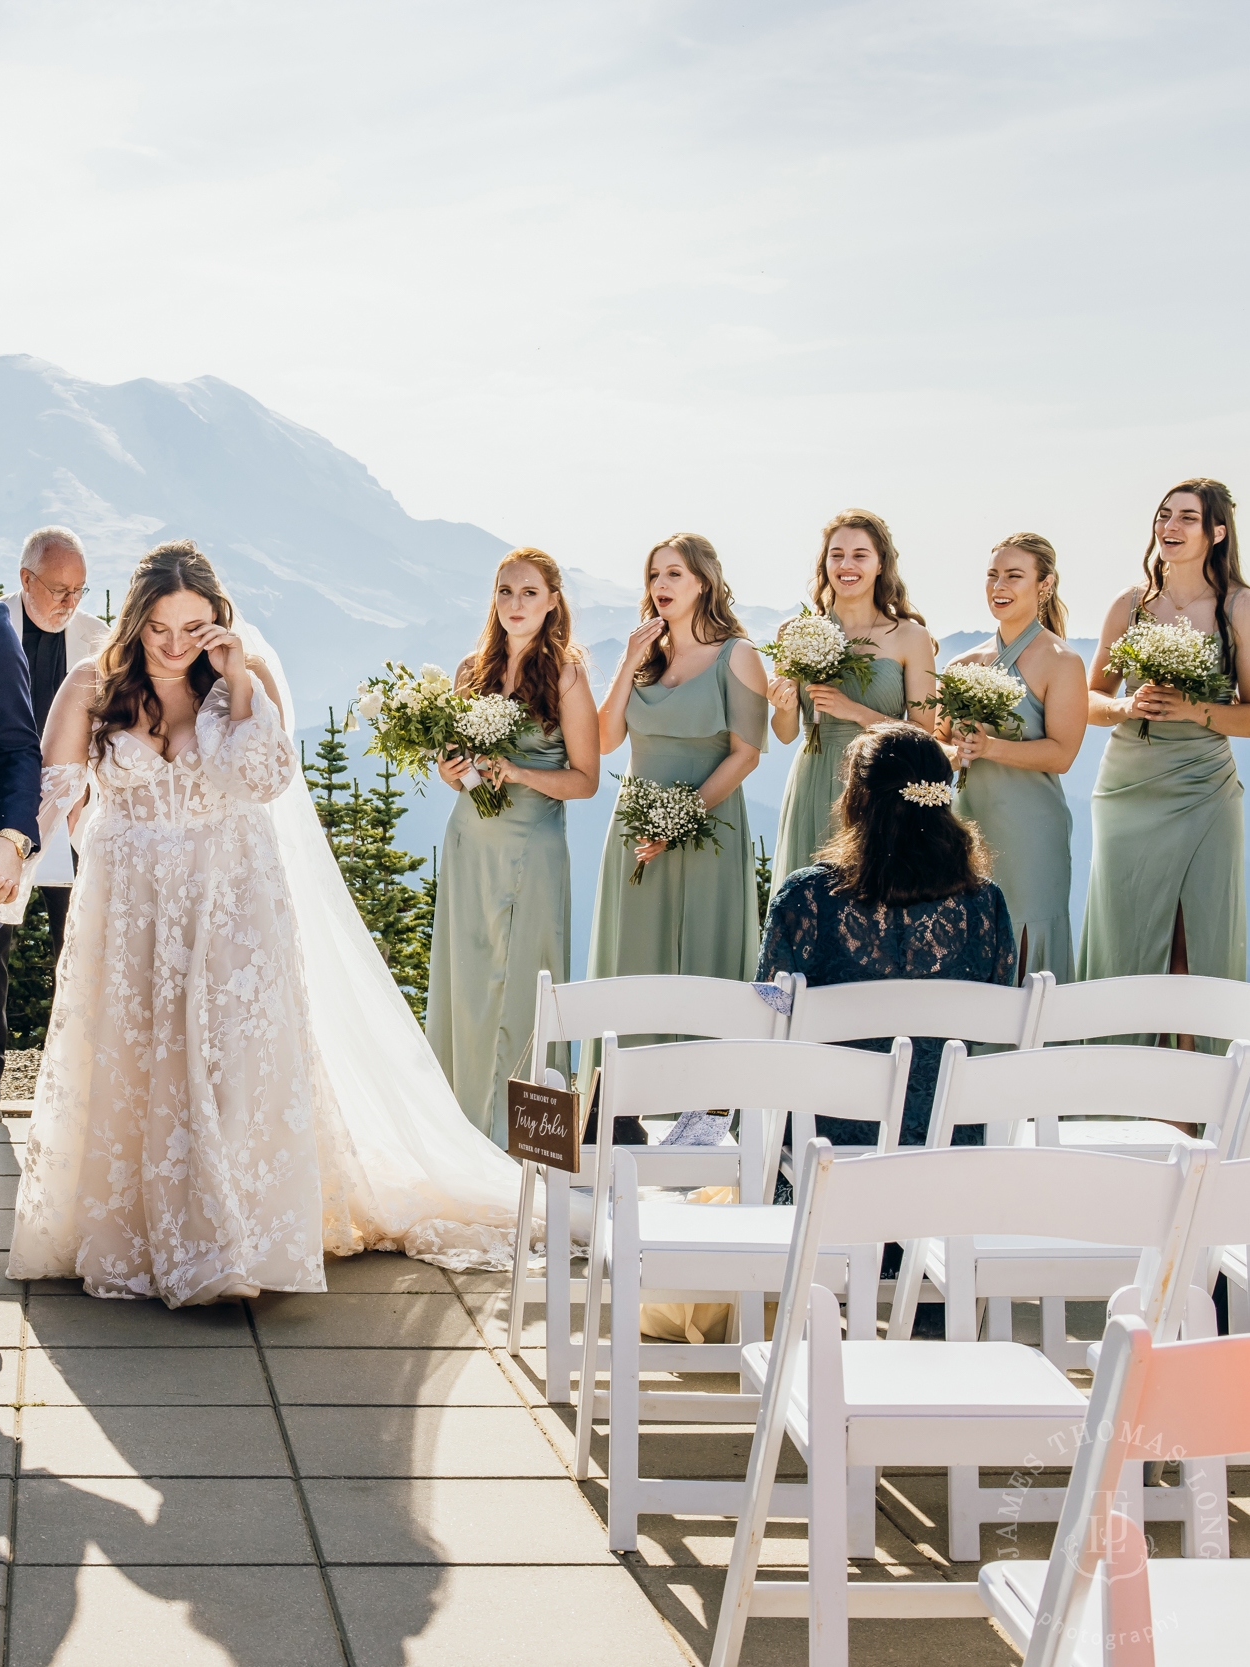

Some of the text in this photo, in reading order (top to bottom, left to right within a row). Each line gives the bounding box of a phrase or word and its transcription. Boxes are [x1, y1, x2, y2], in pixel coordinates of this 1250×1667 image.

[529, 1092, 549, 1103] MEMORY
[550, 1097, 557, 1105] OF
[514, 1105, 568, 1138] Terry Baker
[518, 1142, 534, 1152] FATHER
[541, 1148, 549, 1157] THE
[550, 1151, 563, 1160] BRIDE
